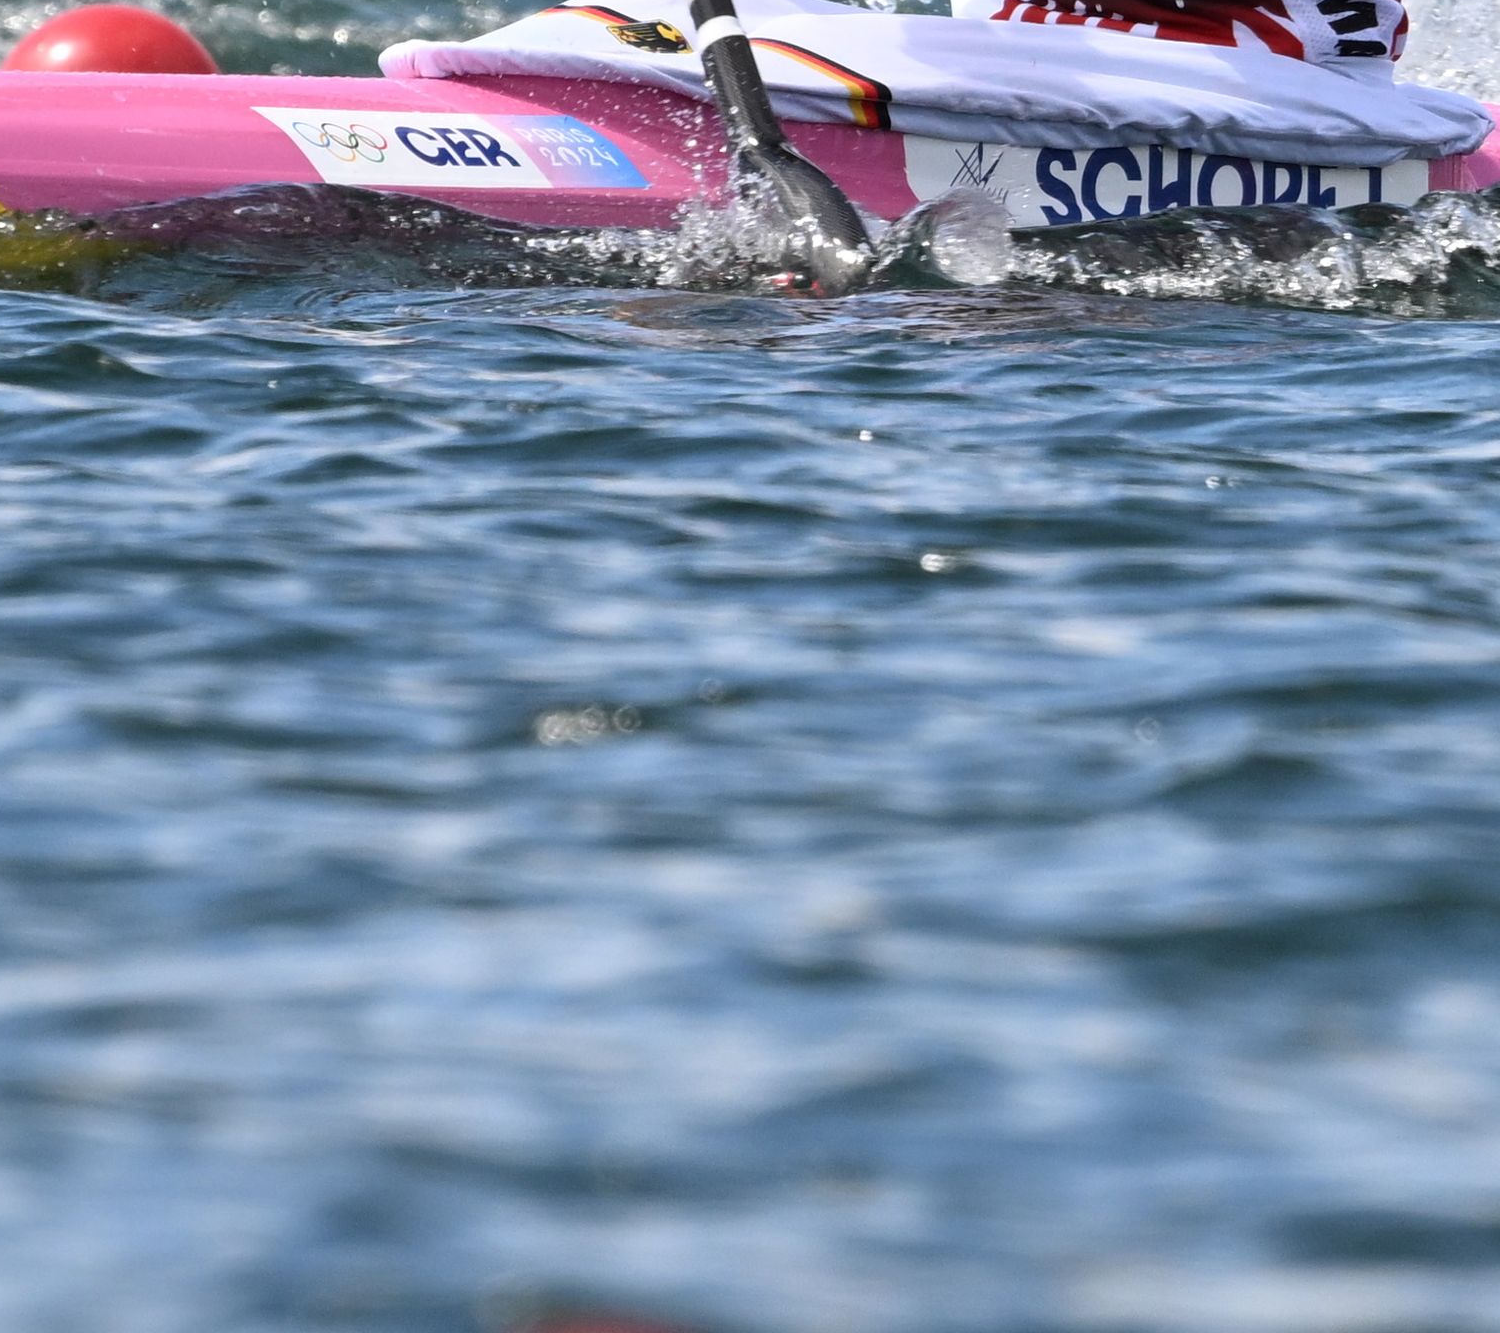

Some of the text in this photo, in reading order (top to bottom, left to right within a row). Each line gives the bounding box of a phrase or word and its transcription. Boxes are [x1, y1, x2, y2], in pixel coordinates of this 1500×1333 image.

[394, 125, 522, 167] GER
[513, 127, 596, 144] PARIS
[538, 145, 619, 167] 2024
